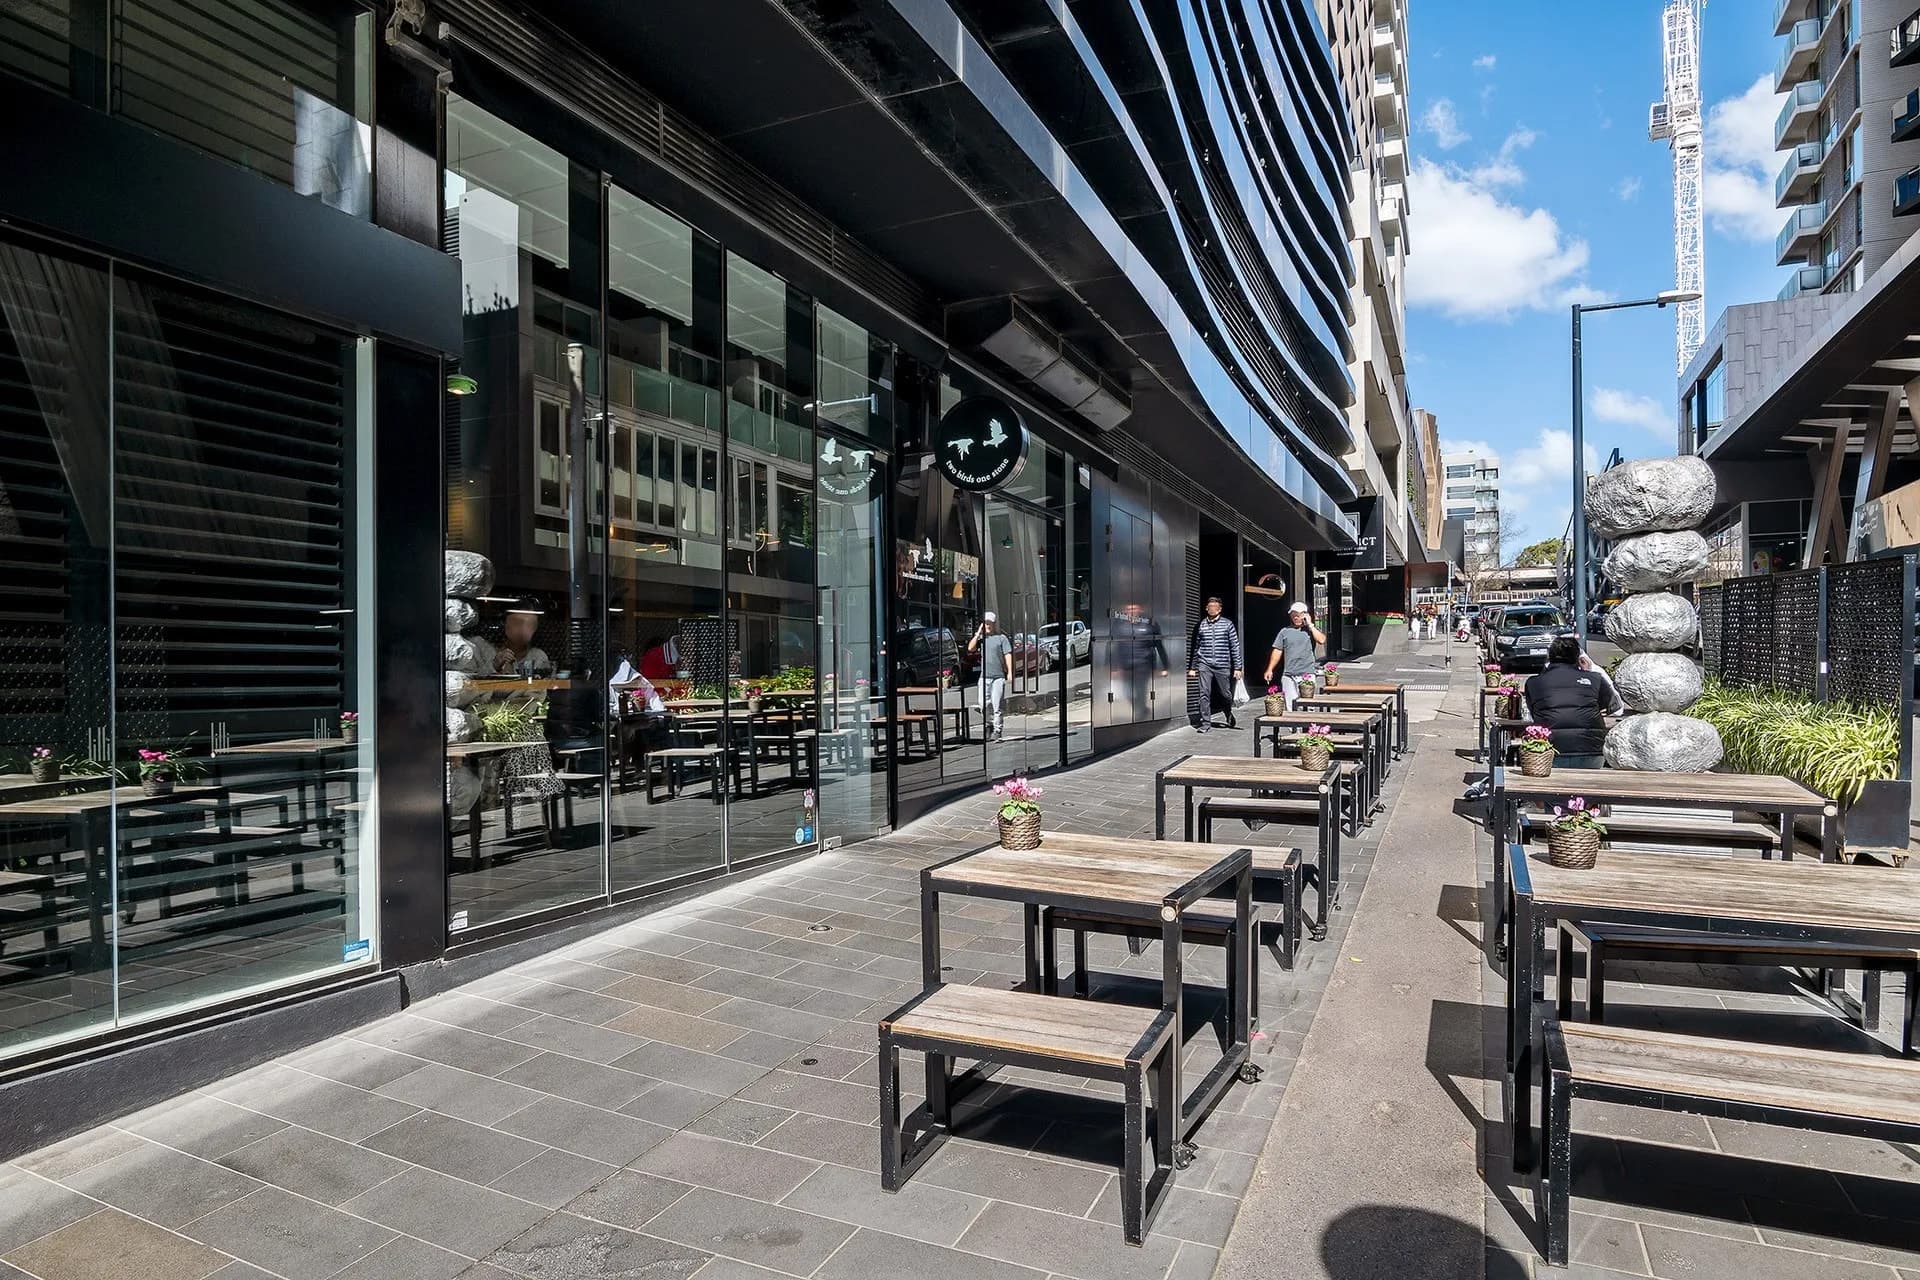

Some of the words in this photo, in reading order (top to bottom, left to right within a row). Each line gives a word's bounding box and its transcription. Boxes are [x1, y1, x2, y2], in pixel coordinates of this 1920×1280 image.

[945, 460, 957, 474] two
[956, 470, 975, 483] birds
[976, 474, 991, 483] one
[991, 458, 1009, 477] stone
[1358, 537, 1376, 546] ICT
